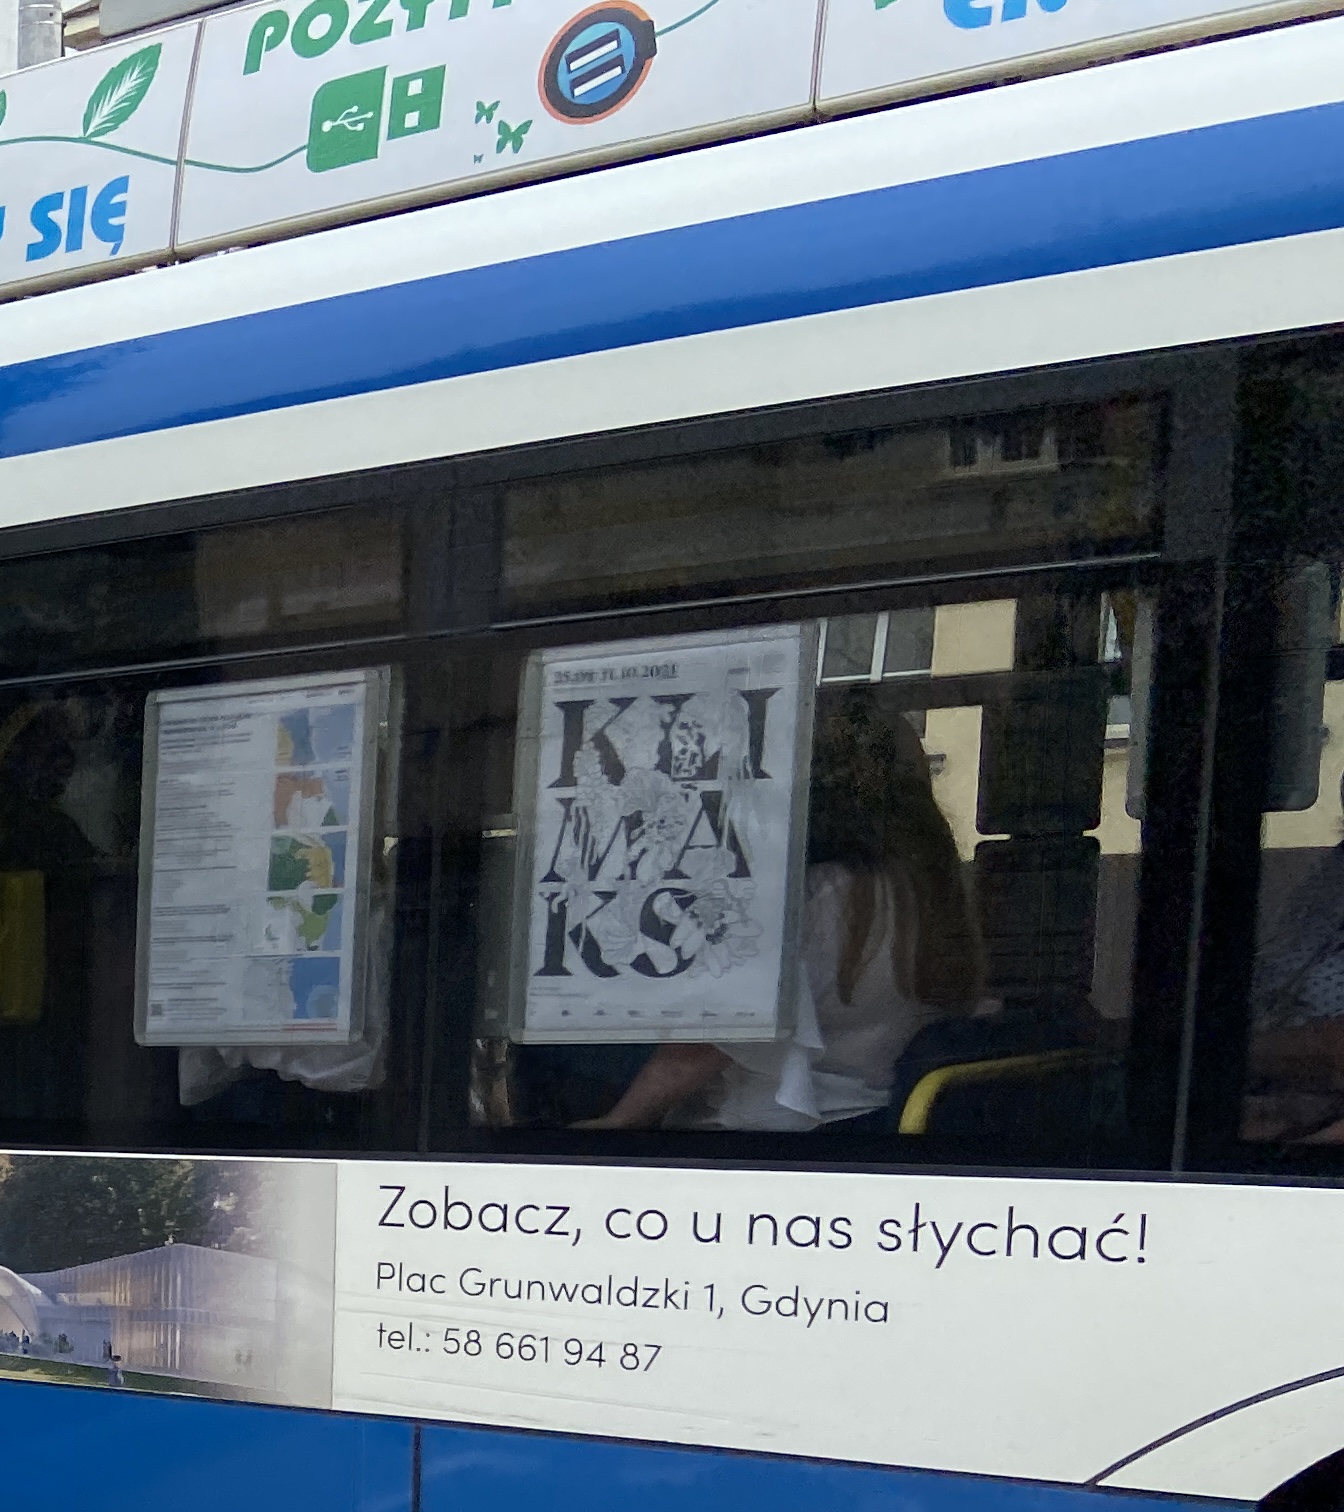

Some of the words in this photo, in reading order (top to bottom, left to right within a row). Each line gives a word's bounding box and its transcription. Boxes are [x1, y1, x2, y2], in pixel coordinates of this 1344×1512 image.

[25, 174, 130, 263] SIĘ
[378, 1185, 582, 1246] Zobacz,
[605, 1207, 668, 1240] co
[692, 1211, 722, 1243] u
[748, 1211, 853, 1250] nas
[877, 1202, 1148, 1269] słychać!
[376, 1261, 446, 1295] Plac
[459, 1267, 690, 1311] Grunwaldzki
[703, 1283, 725, 1319] 1,
[742, 1284, 889, 1328] Gdynia
[377, 1321, 431, 1352] tel.:
[442, 1328, 482, 1356] 58
[495, 1332, 550, 1363] 661
[564, 1338, 607, 1368] 94
[619, 1342, 662, 1372] 87
